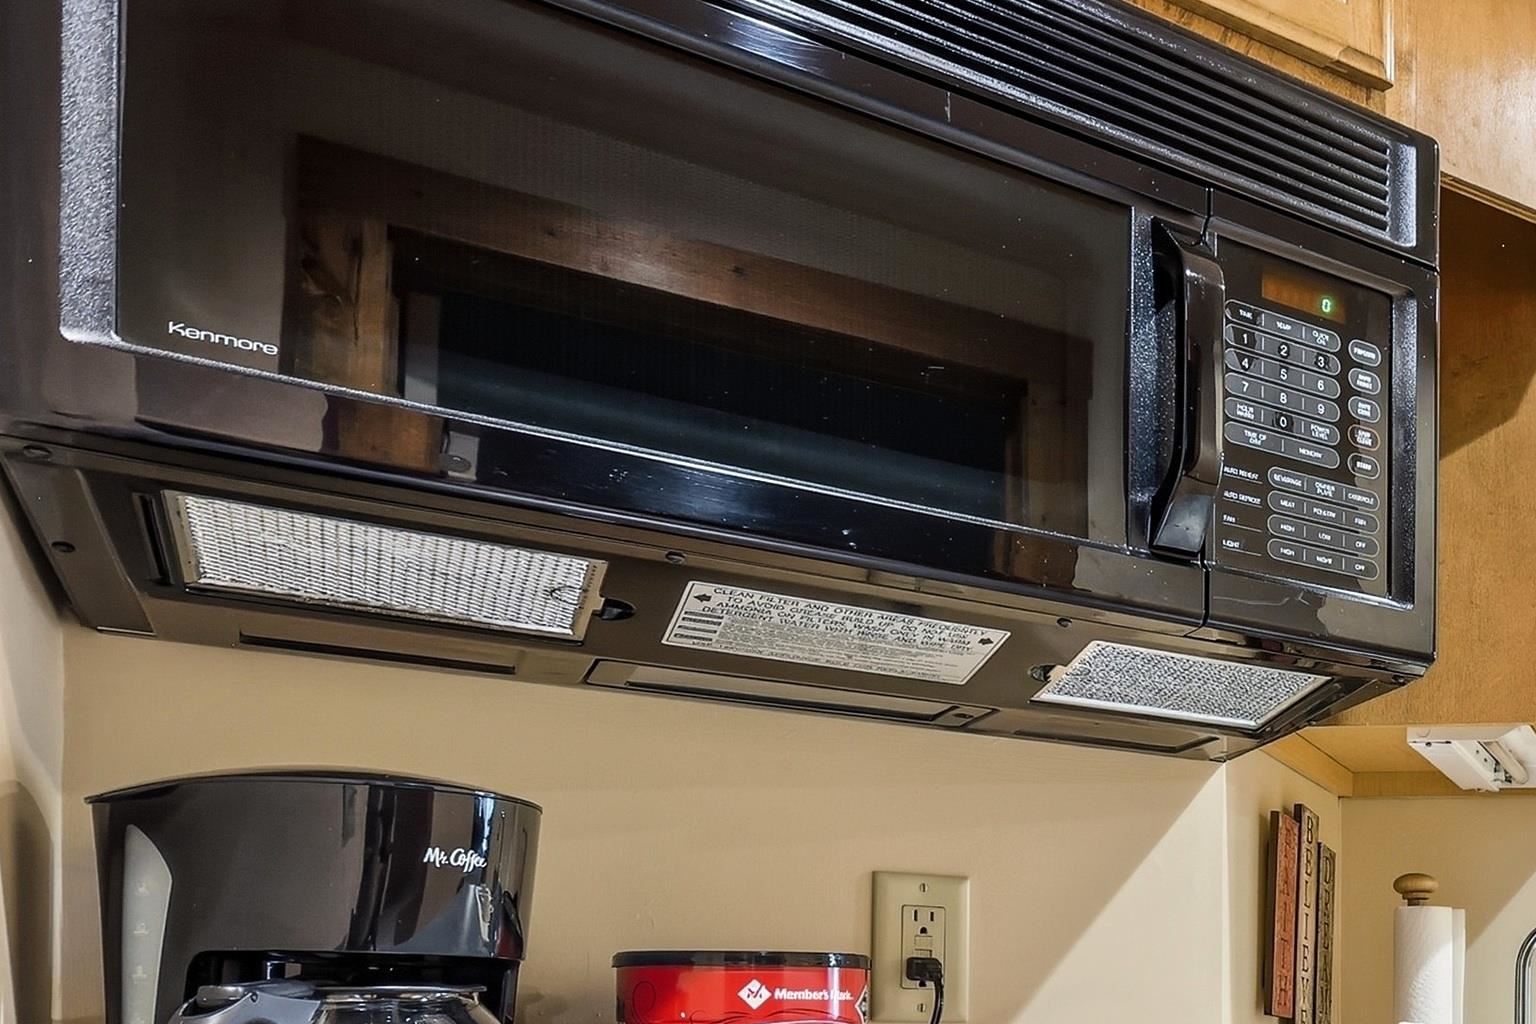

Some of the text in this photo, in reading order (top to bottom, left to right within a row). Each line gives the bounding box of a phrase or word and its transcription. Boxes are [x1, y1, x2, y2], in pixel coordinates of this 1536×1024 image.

[1321, 299, 1332, 313] 0
[168, 321, 279, 356] Kenmore
[1242, 333, 1248, 344] 1
[1280, 345, 1288, 356] 2
[1241, 358, 1249, 369] 4
[1317, 356, 1325, 368] 3
[1280, 369, 1288, 380] 5
[1241, 381, 1249, 392] 7
[1317, 380, 1325, 391] 6
[1280, 393, 1287, 404] 8
[1317, 404, 1325, 414] 9
[1280, 416, 1287, 428] 0
[1280, 499, 1295, 509] MEAT
[1318, 532, 1331, 541] LOW
[713, 587, 754, 599] CLEAN
[759, 594, 799, 607] FILTER
[805, 602, 830, 613] AND
[833, 607, 873, 619] OTHER
[877, 614, 913, 626] AREAS
[716, 601, 772, 616] AMMONIA
[727, 596, 743, 604] TO
[749, 600, 785, 611] AVOID
[789, 607, 836, 619] GREASE
[702, 605, 774, 622] DETERGENT
[779, 617, 820, 630] WATER
[423, 847, 487, 873] Mr. Coffee
[774, 988, 829, 1000] Member's
